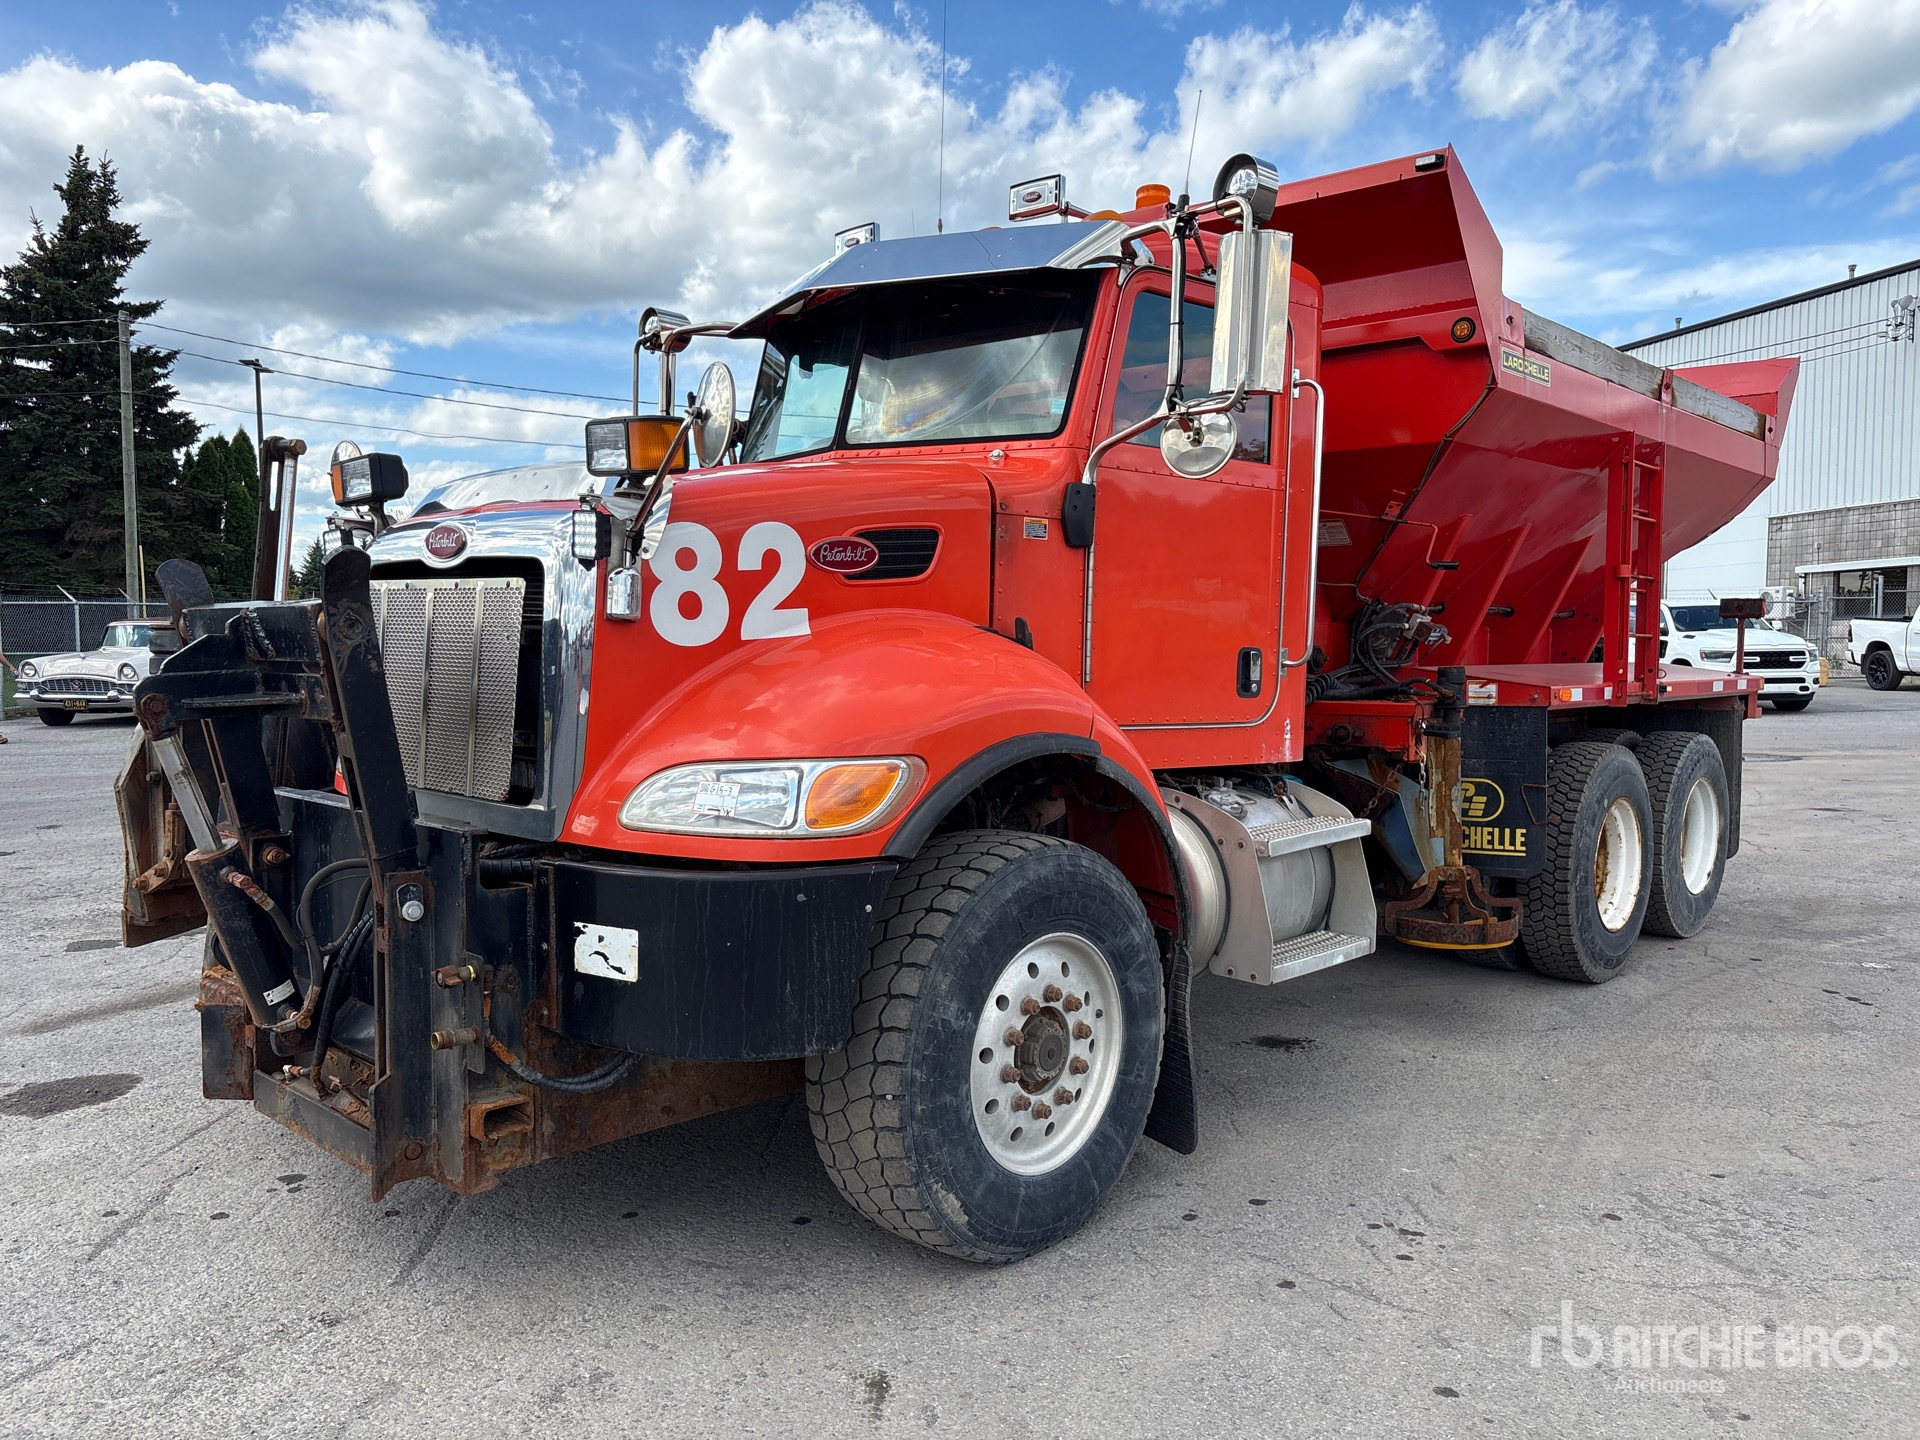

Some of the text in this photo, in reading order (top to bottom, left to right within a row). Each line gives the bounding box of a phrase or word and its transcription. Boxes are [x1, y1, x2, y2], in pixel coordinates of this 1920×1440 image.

[1503, 353, 1549, 381] LAROCHELLE
[429, 531, 460, 550] Peterbilt
[820, 544, 872, 562] Peterbilt
[649, 521, 812, 647] 82
[1461, 826, 1527, 851] CHELLE
